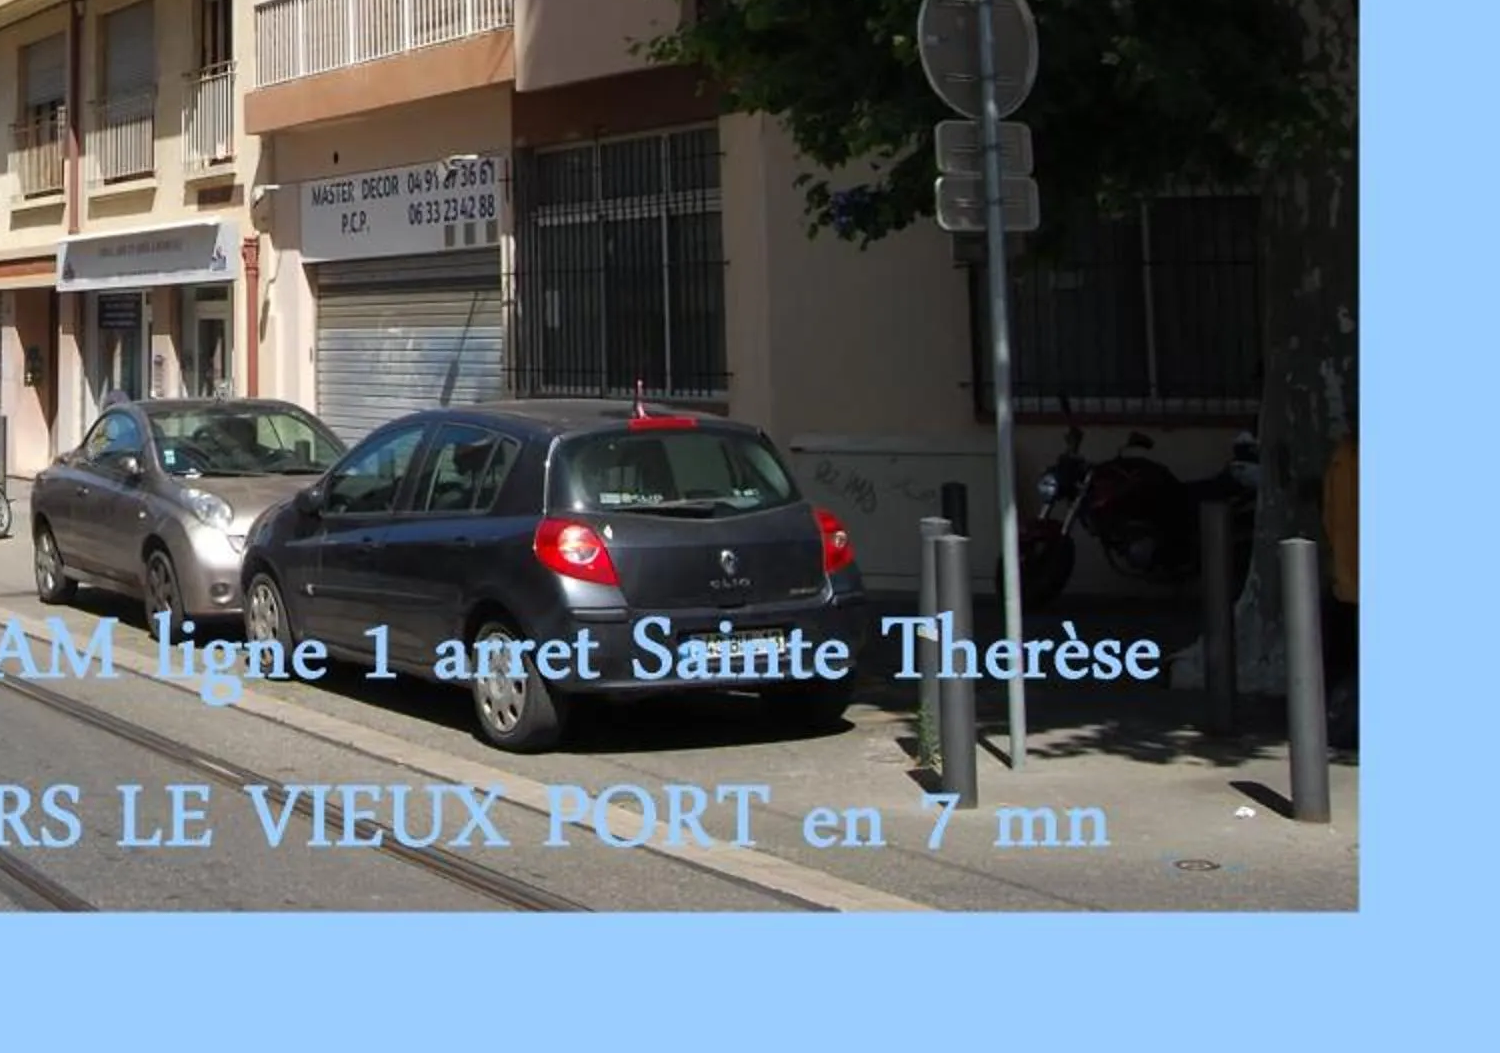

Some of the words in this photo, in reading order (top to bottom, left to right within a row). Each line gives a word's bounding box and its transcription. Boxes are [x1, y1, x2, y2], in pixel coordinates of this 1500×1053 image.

[311, 181, 354, 206] MASTER
[362, 175, 399, 200] DECOR
[407, 172, 423, 194] 04
[425, 169, 439, 192] 91
[460, 163, 477, 187] 36
[408, 201, 423, 225] 06
[426, 200, 441, 223] 33
[479, 194, 495, 218] 88
